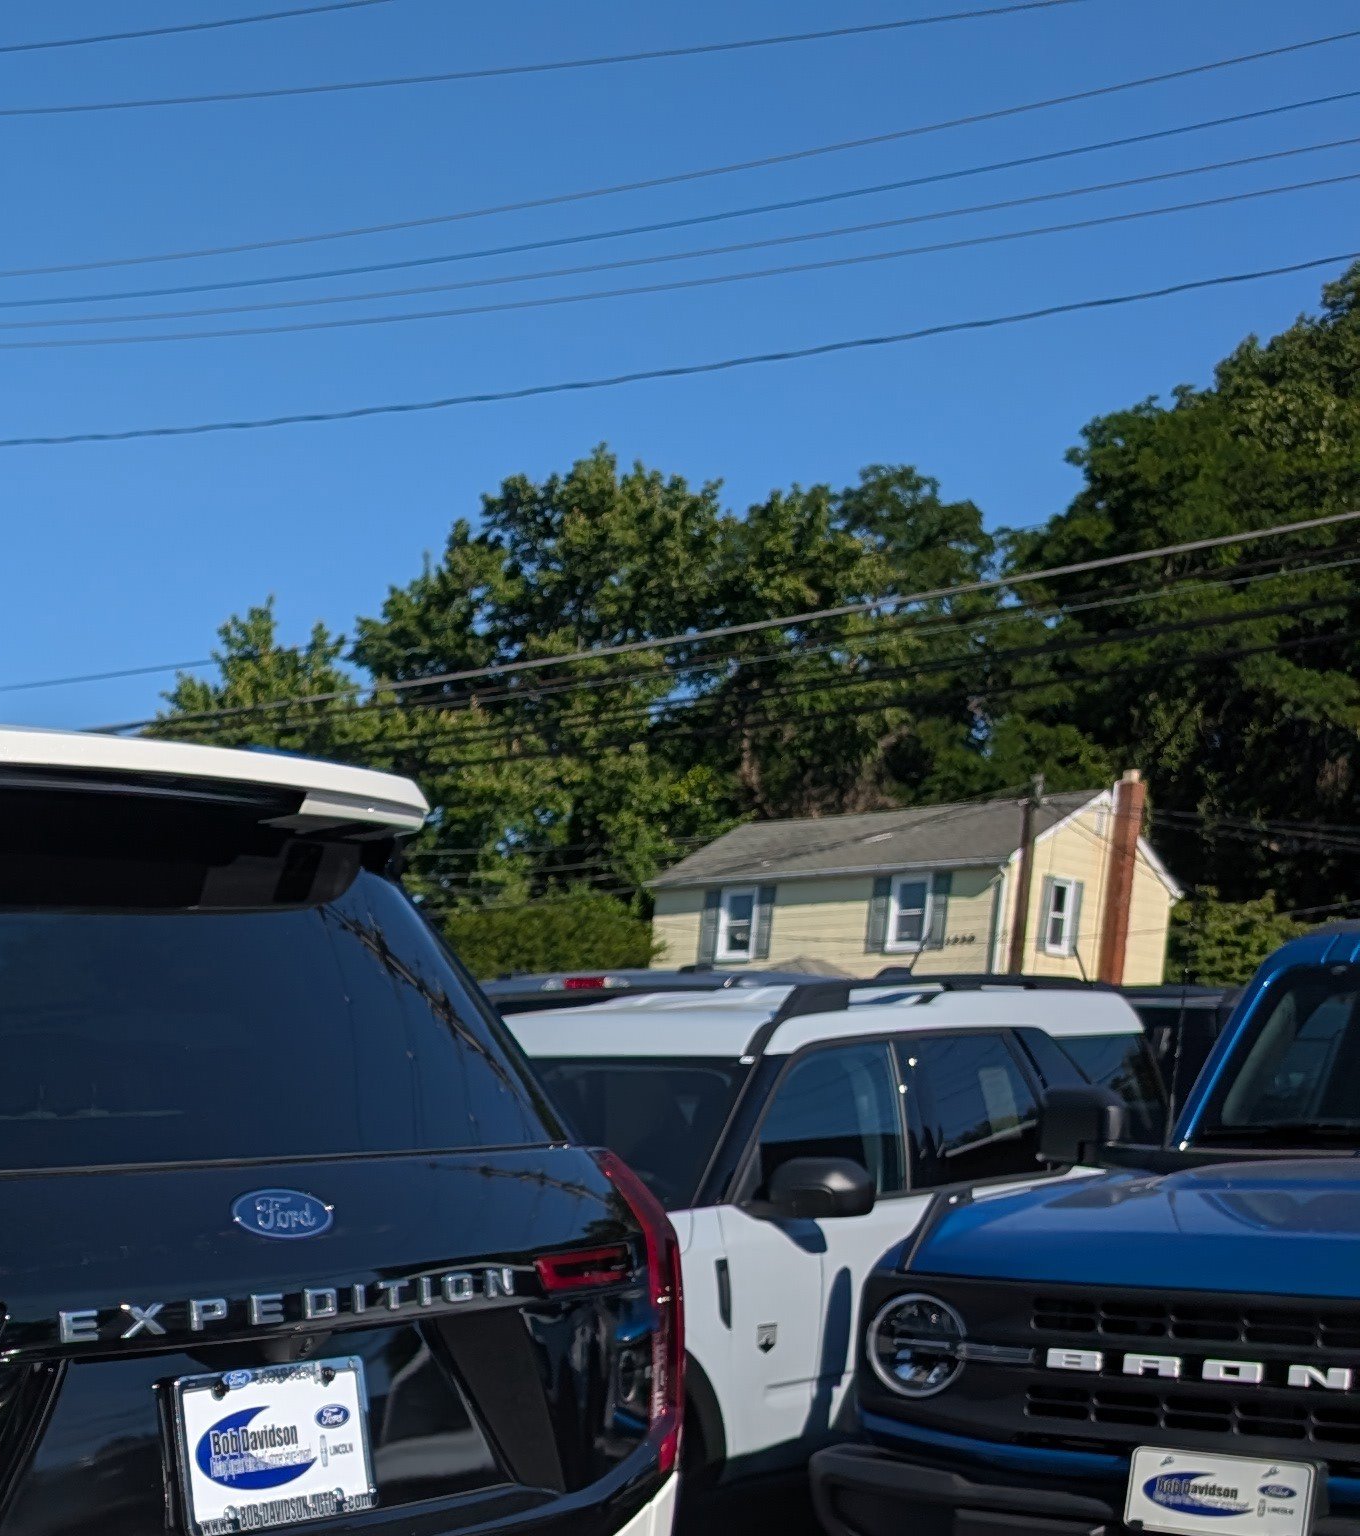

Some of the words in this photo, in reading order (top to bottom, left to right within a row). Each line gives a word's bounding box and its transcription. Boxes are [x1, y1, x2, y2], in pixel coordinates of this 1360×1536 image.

[59, 1266, 514, 1344] EXPEDITION
[1045, 1347, 1352, 1390] BRON
[210, 1428, 239, 1456] Bob
[240, 1424, 298, 1452] Davidson
[329, 1444, 354, 1457] LINCOLN
[1181, 1478, 1239, 1500] Davidson
